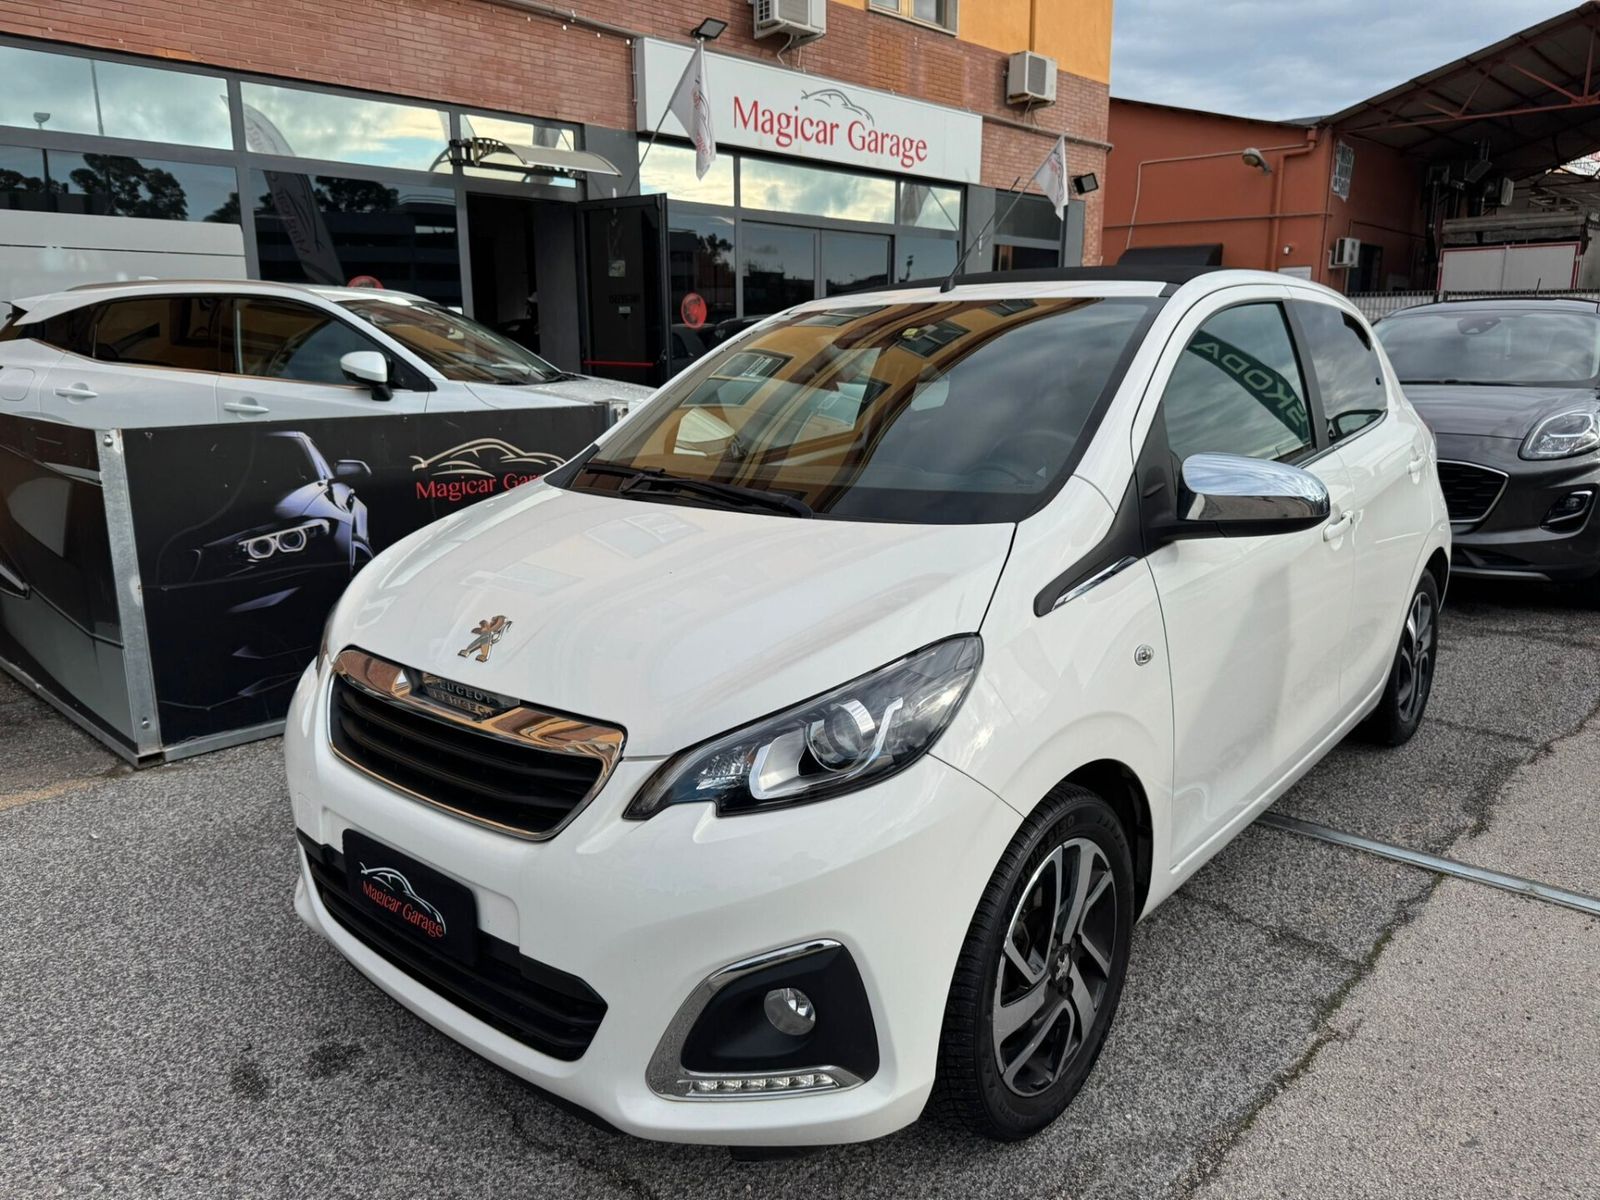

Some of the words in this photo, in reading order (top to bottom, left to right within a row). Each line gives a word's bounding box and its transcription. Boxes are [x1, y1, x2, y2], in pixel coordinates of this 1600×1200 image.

[733, 95, 839, 148] Magicar
[847, 119, 928, 169] Garage
[415, 475, 497, 502] Magicar
[503, 472, 543, 490] Gar
[362, 880, 402, 913] Magicar
[402, 903, 444, 938] Garage
